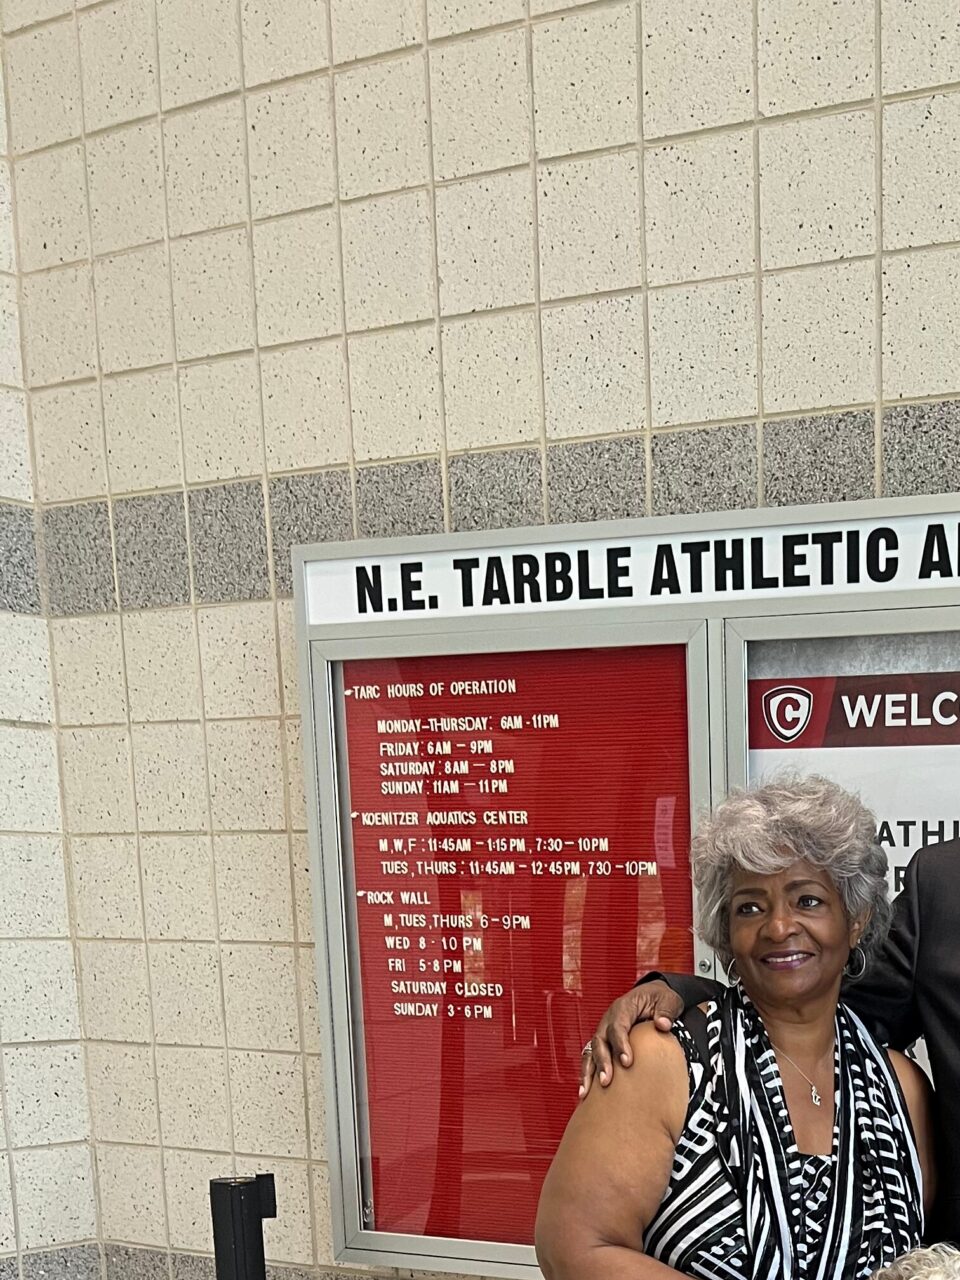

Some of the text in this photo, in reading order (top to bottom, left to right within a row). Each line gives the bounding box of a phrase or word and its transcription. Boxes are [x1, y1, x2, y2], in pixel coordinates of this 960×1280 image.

[355, 561, 439, 615] N.E.
[453, 546, 634, 608] TARBLE
[650, 526, 900, 598] ATHLETIC
[353, 679, 516, 699] TARC HOURS OF OPERATION
[776, 696, 801, 731] C
[501, 715, 523, 730] 6AM
[380, 741, 424, 757] FRIDAY:
[433, 780, 459, 794] 11AM
[361, 811, 528, 826] KOENITZER AQUATICS CENTER
[427, 838, 471, 852] 11:45AM
[469, 861, 515, 875] 11:45AM
[367, 891, 431, 905] ROCK WALL
[384, 936, 410, 949] WED
[418, 936, 426, 950] 8
[441, 936, 458, 950] 10
[462, 937, 482, 951] PM
[388, 958, 406, 972] FRI
[391, 980, 503, 996] SATURDAY CLOSED
[393, 1002, 438, 1016] SUNDAY
